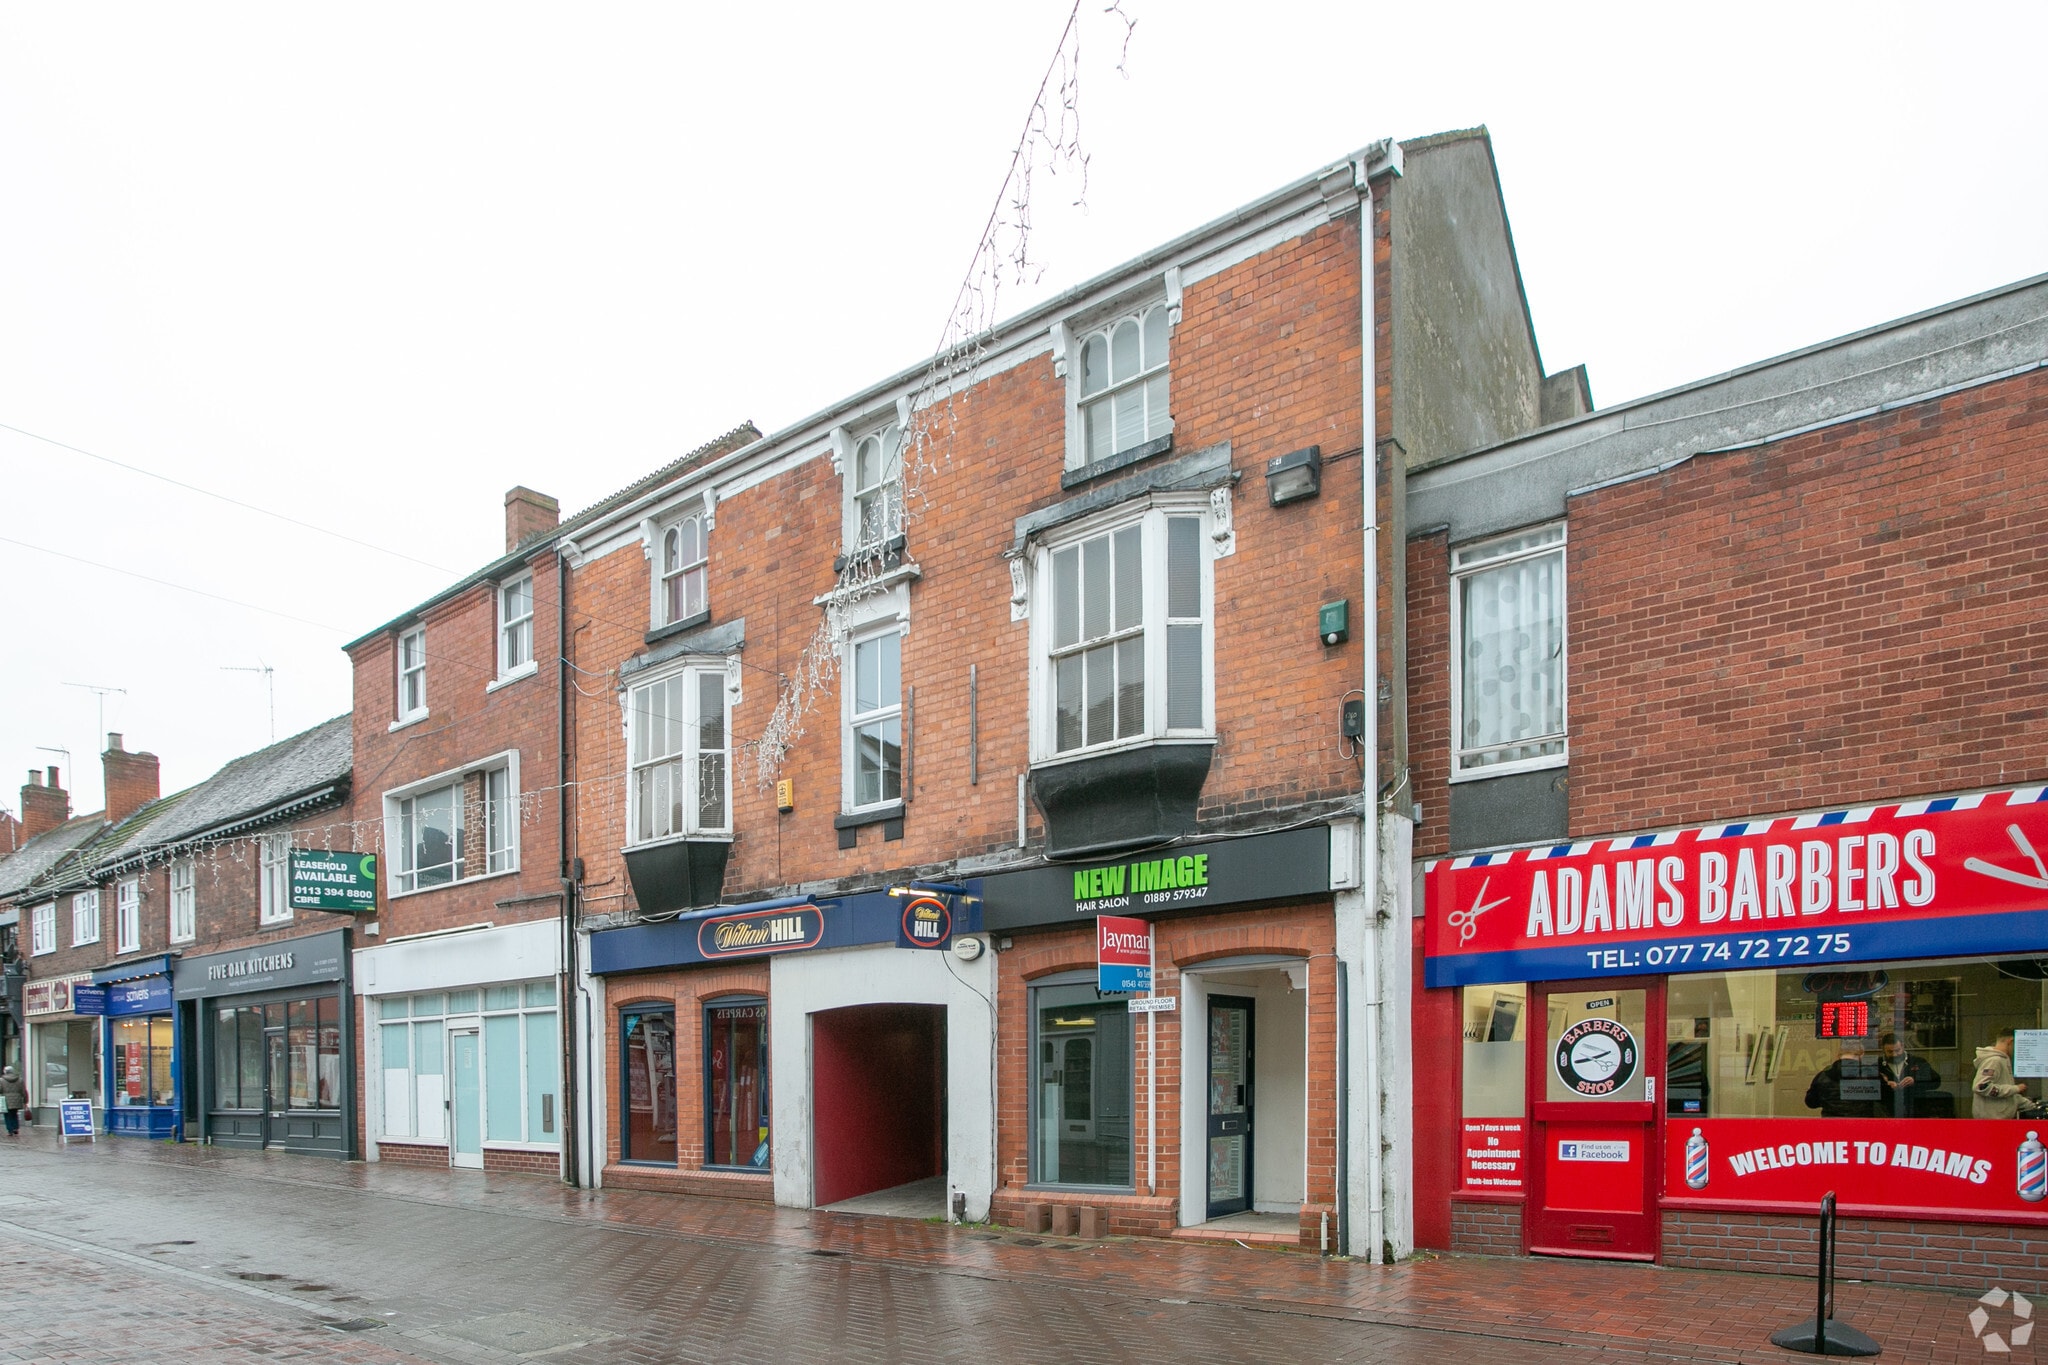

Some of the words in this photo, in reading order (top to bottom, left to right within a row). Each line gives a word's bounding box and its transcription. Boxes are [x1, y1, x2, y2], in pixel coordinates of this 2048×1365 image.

[294, 860, 348, 871] LEASEHOLD
[294, 870, 357, 884] AVAILABLE
[1074, 865, 1127, 900] NEW
[1131, 853, 1208, 893] IMAGE
[1526, 856, 1685, 938] ADAMS
[1699, 828, 1936, 924] BARBERS
[294, 886, 322, 895] 0113
[324, 888, 344, 897] 394
[347, 889, 373, 899] 8800
[1076, 901, 1097, 912] HAIR
[1098, 897, 1130, 909] SALON
[1143, 892, 1171, 904] 01889
[1172, 887, 1208, 901] 579347
[294, 896, 320, 904] CBRE
[714, 920, 772, 949] William
[770, 916, 805, 943] HILL
[914, 920, 940, 938] HILL
[1102, 926, 1150, 953] Jayman
[1587, 950, 1640, 969] TEL:
[1646, 944, 1694, 966] 077
[1700, 941, 1731, 962] 74
[1738, 939, 1770, 959] 72
[1777, 936, 1810, 957] 72
[1817, 933, 1850, 954] 75
[208, 964, 227, 981] FIVE
[228, 961, 246, 977] OAK
[248, 952, 293, 975] KITCHENS
[1136, 968, 1143, 978] To
[126, 987, 149, 1002] scrivens
[1590, 1000, 1610, 1008] OPEN
[1563, 1020, 1628, 1045] BARBERS
[1576, 1079, 1615, 1094] SHOP
[1465, 1124, 1480, 1132] Open
[1484, 1124, 1499, 1132] days
[1487, 1136, 1499, 1146] No
[1466, 1148, 1521, 1159] Appointment
[1581, 1150, 1623, 1158] Facebook
[1471, 1160, 1516, 1171] Necessary
[1728, 1141, 1849, 1177] WELCOME
[1853, 1141, 1887, 1166] TO
[1890, 1143, 1992, 1184] ADAMS
[1493, 1178, 1522, 1186] Welcome
